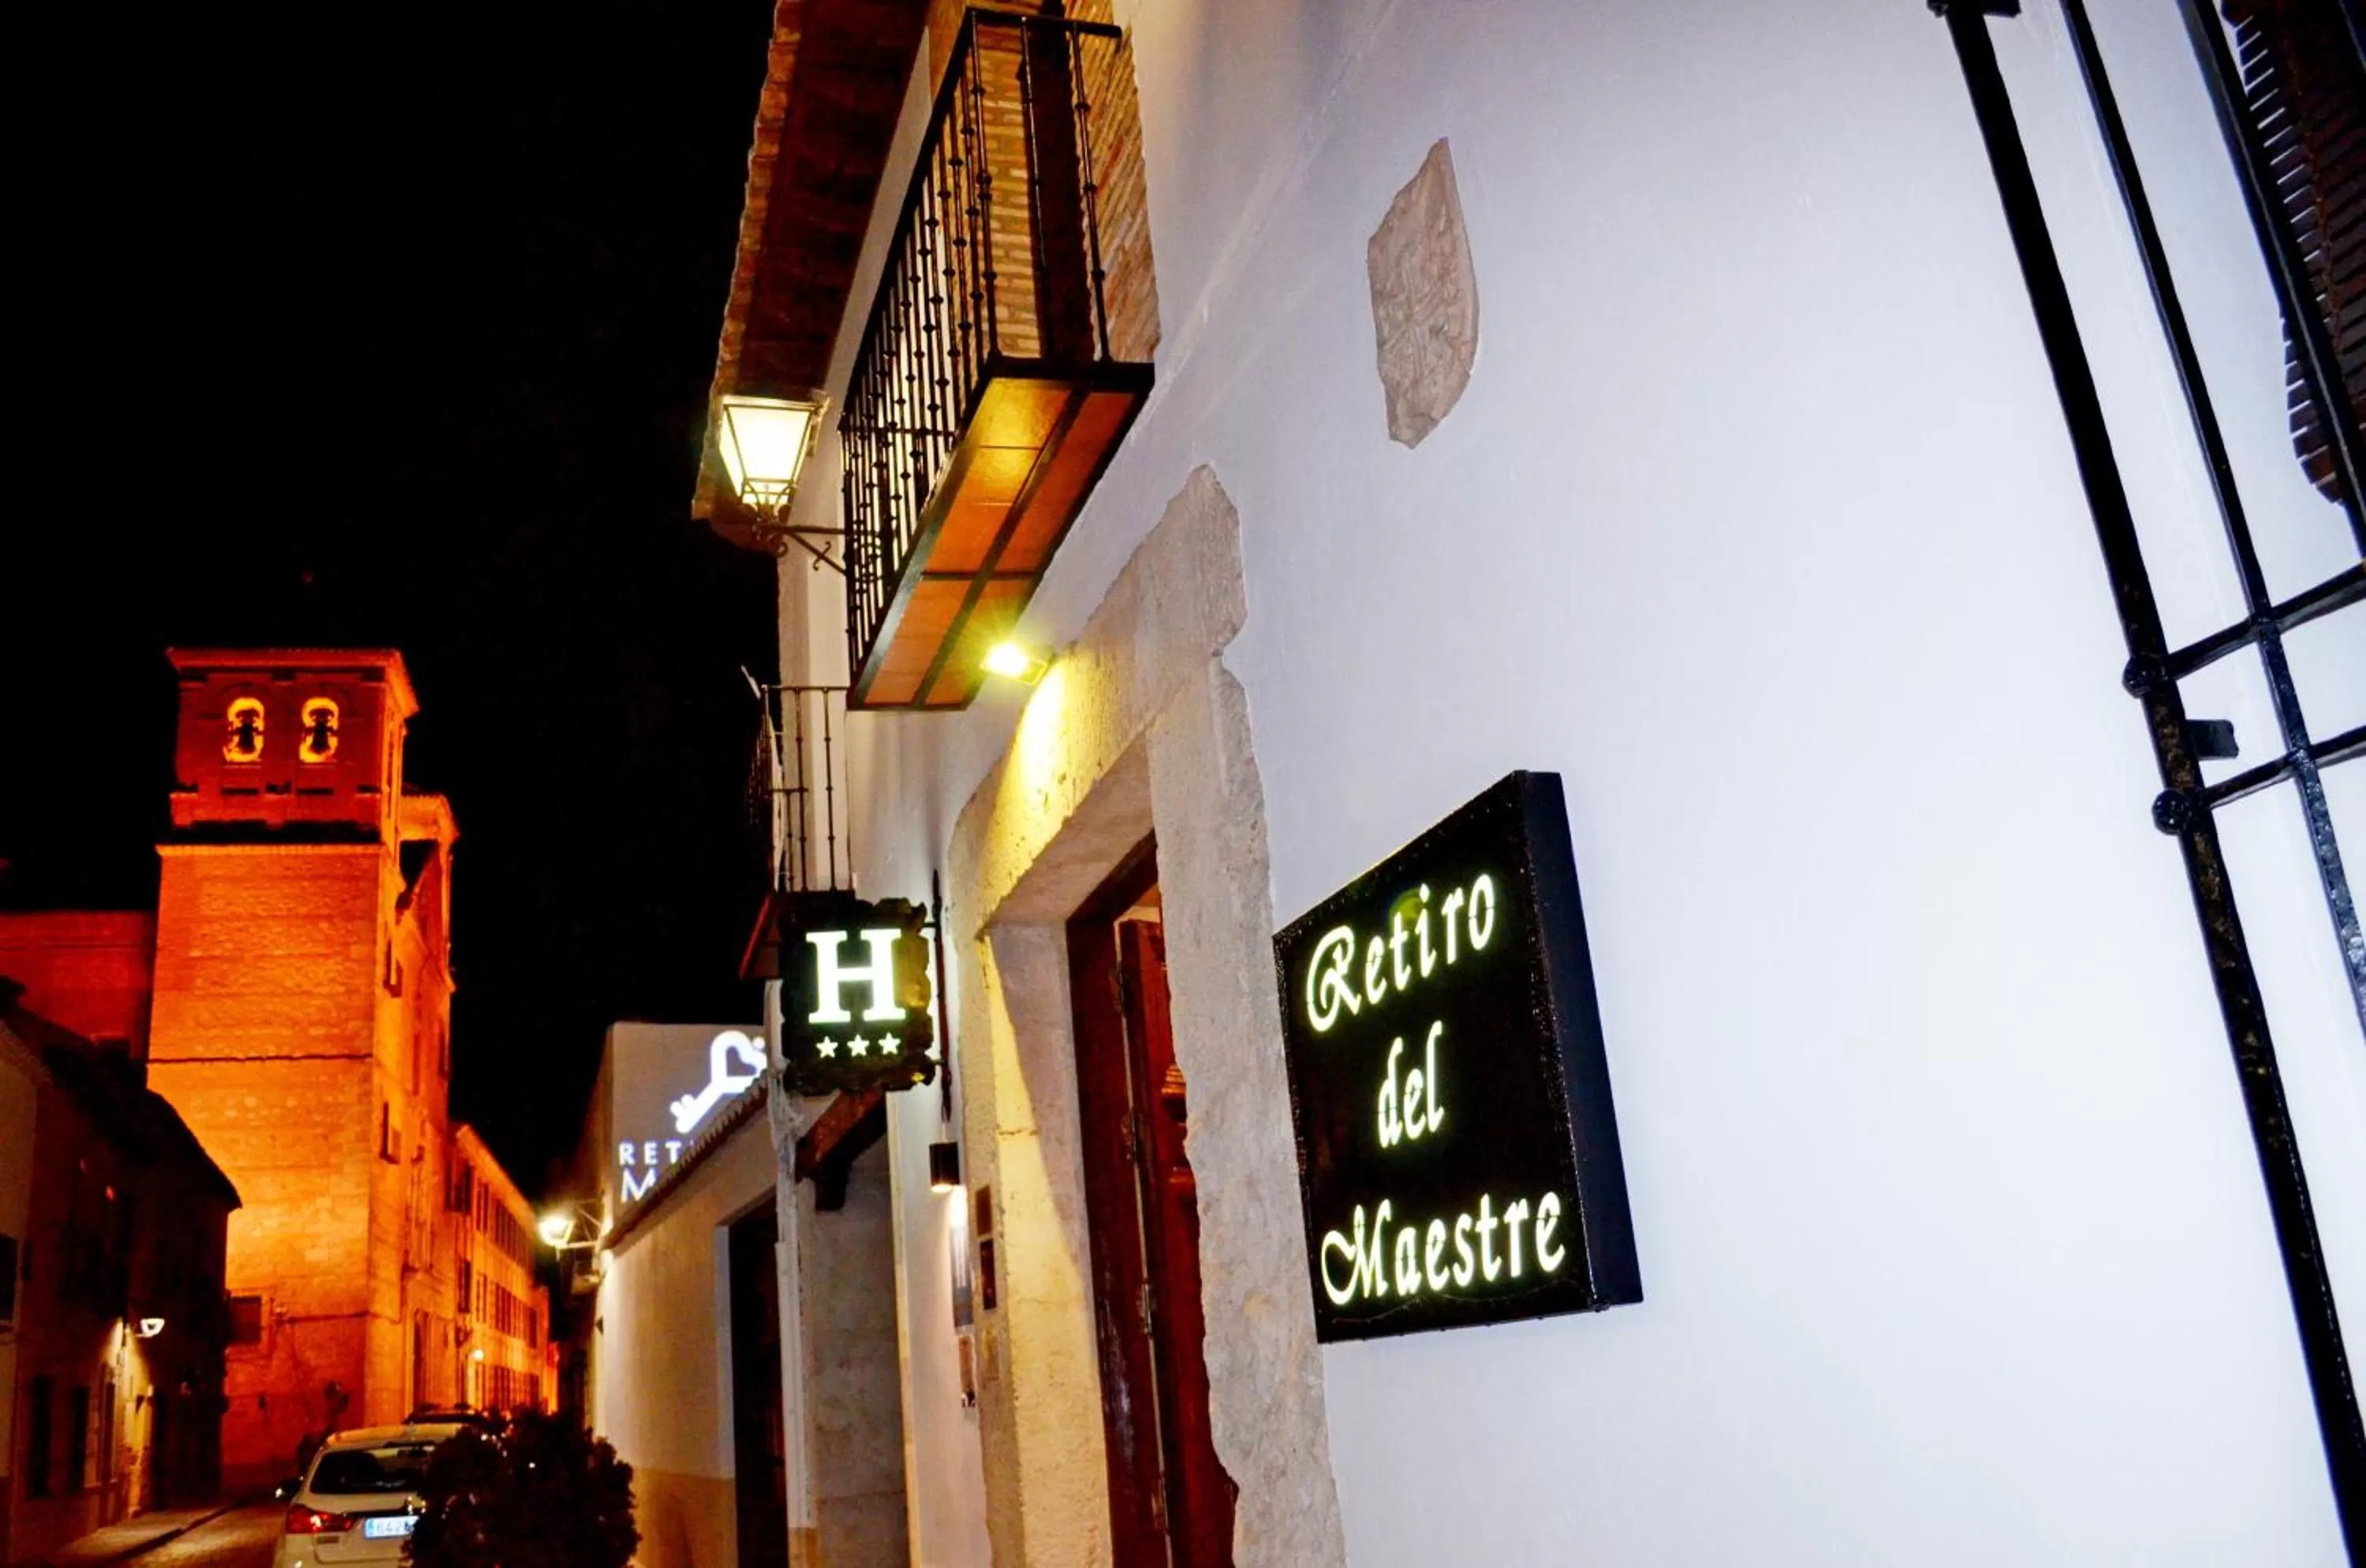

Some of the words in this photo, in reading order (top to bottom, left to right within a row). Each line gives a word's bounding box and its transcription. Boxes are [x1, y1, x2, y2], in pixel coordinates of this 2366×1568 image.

[805, 928, 906, 1024] H
[1307, 874, 1496, 1032] Retiro
[1379, 1021, 1444, 1148] del
[618, 1140, 693, 1166] RET
[1321, 1192, 1565, 1305] Maestre
